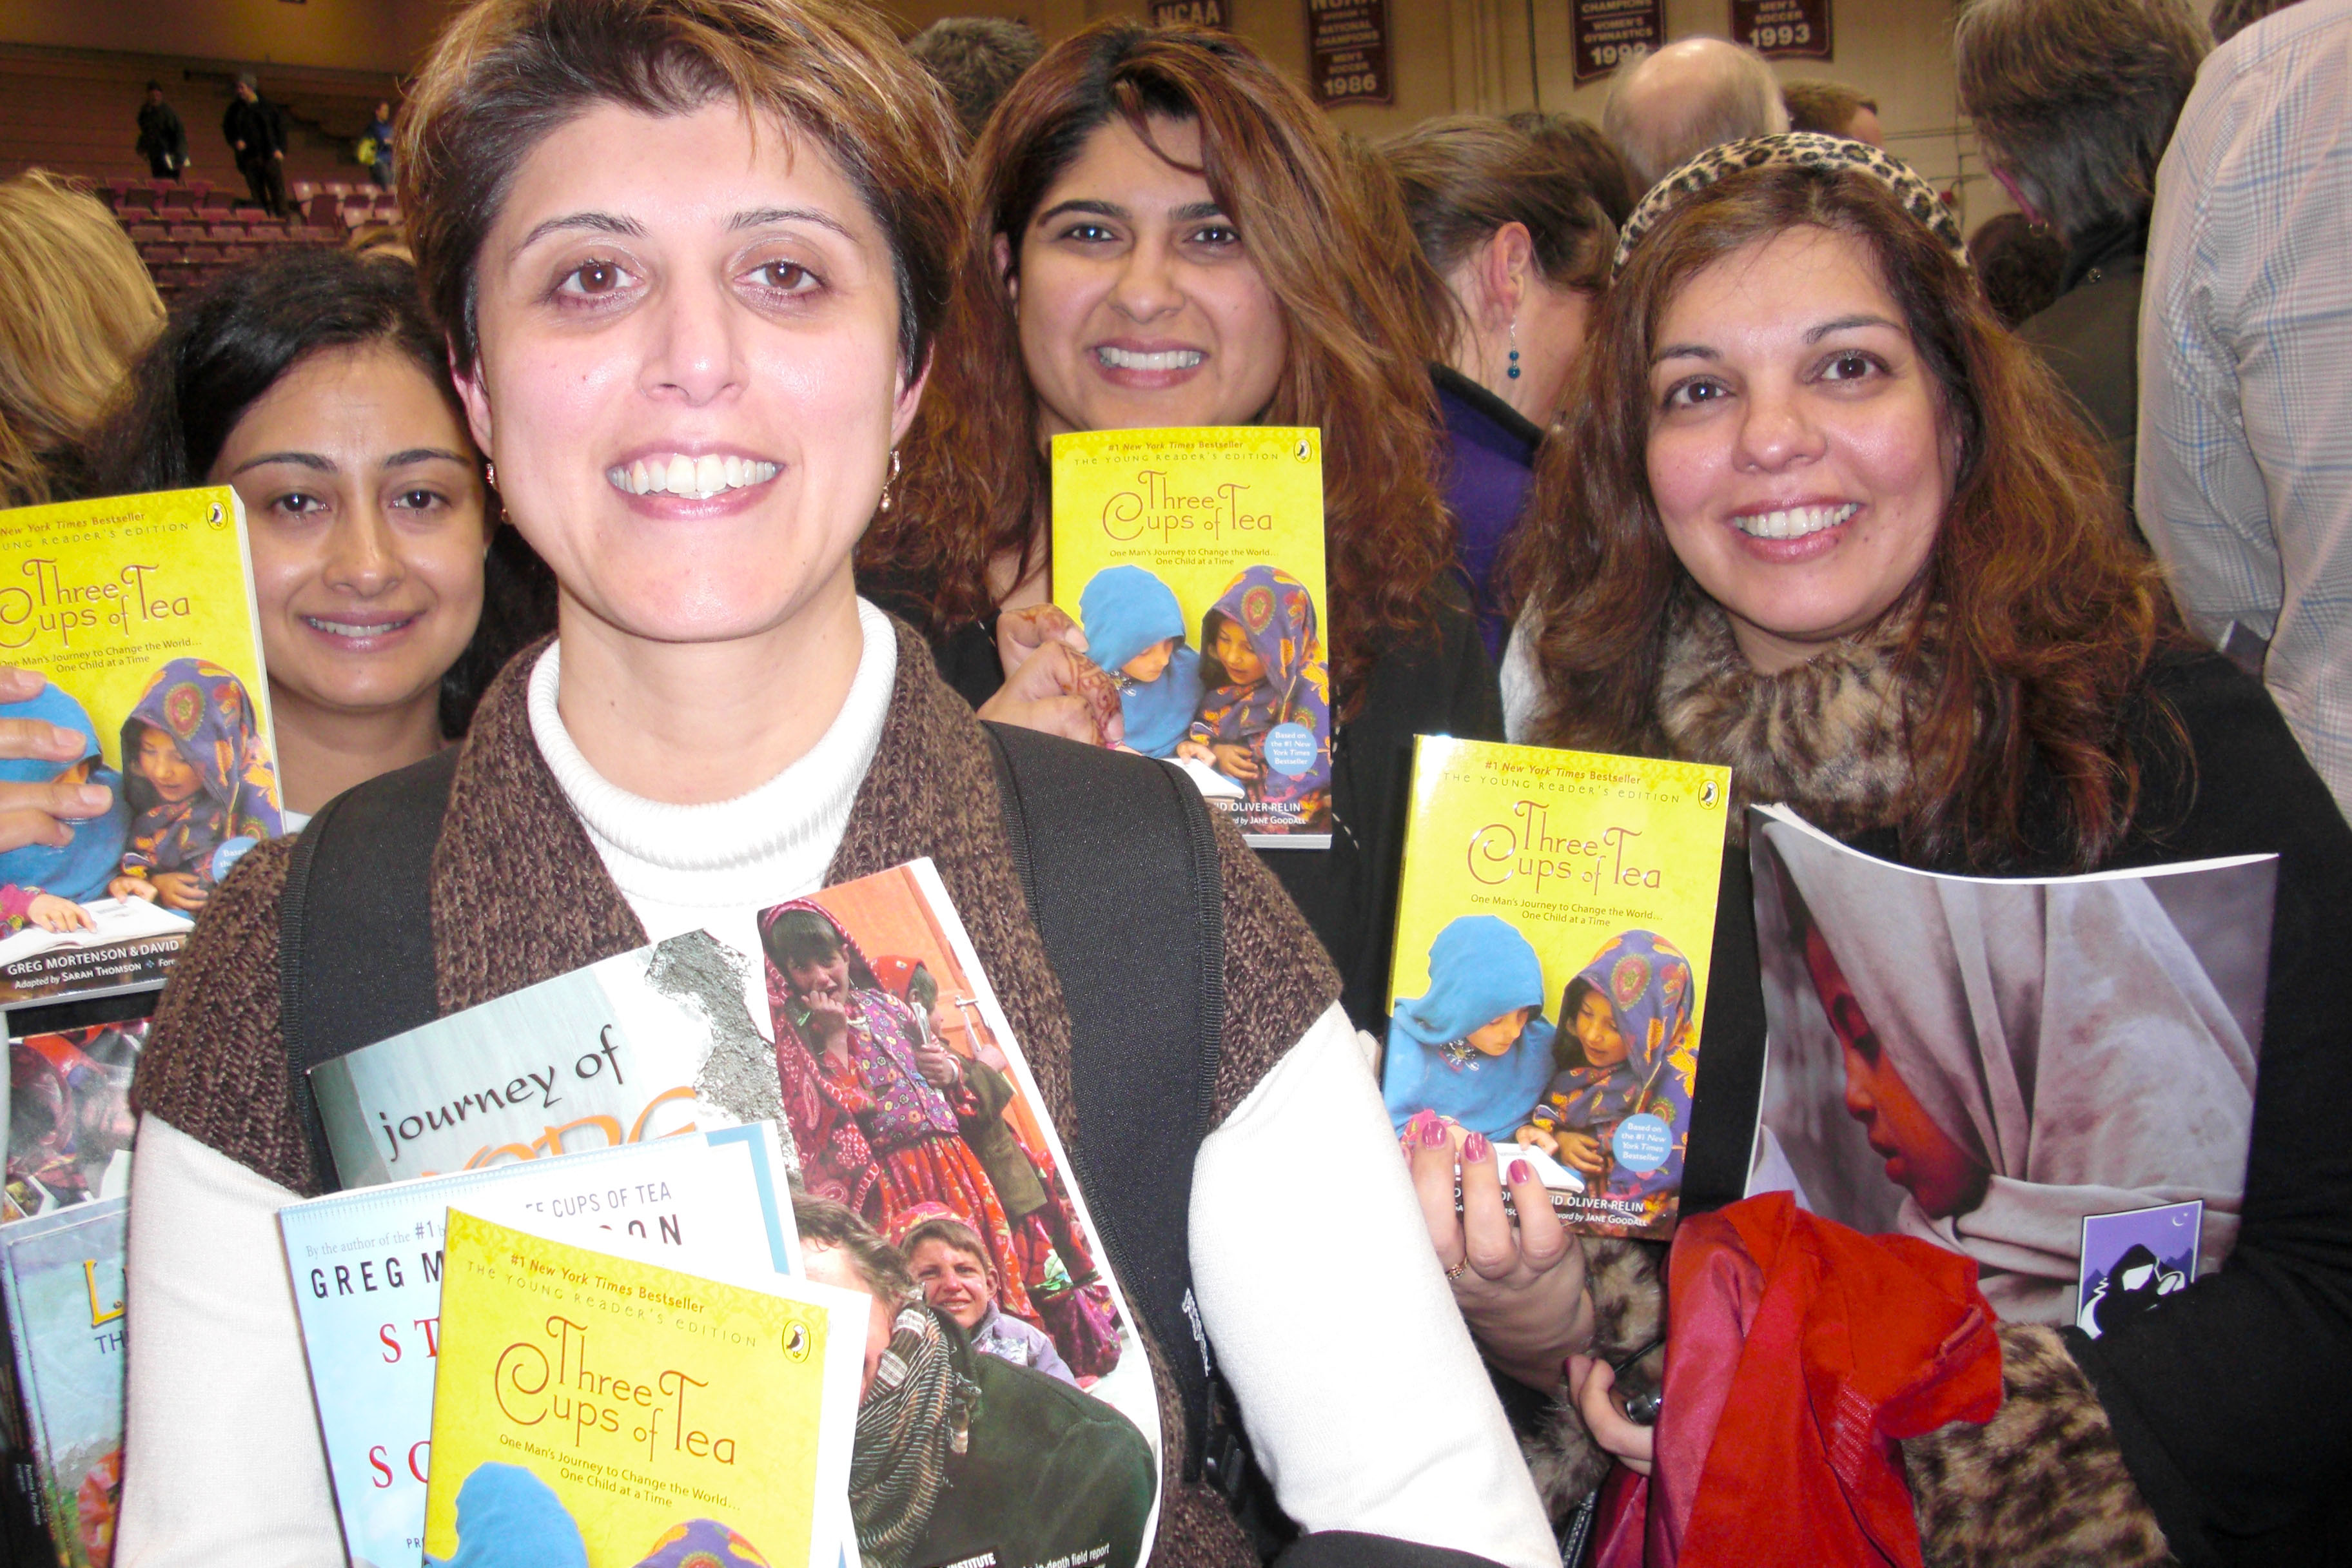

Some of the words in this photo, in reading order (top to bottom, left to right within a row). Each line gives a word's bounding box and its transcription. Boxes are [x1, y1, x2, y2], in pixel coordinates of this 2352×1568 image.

[1158, 0, 1220, 26] NCAA
[1755, 10, 1803, 24] SOCCER
[1750, 22, 1810, 47] 1993
[1324, 74, 1377, 95] 1986
[1108, 443, 1119, 451] #1
[1137, 470, 1214, 509] Three
[0, 527, 21, 536] New
[28, 524, 51, 533] York
[57, 520, 87, 529] Times
[92, 513, 145, 525] Bestseller
[1102, 492, 1194, 543] Cups
[1204, 507, 1222, 540] of
[1218, 483, 1272, 531] Tea
[126, 522, 189, 536] EDITION
[1153, 549, 1186, 558] Journey
[1198, 548, 1229, 558] Change
[22, 558, 119, 607] Three
[0, 587, 97, 649] Cups
[108, 595, 129, 637] of
[121, 564, 191, 621] Tea
[23, 656, 50, 665] Man's
[52, 651, 91, 663] Journey
[106, 645, 142, 656] Change
[145, 642, 161, 651] the
[56, 664, 76, 673] One
[79, 660, 104, 670] Child
[127, 655, 150, 664] Time
[1485, 761, 1498, 770] #1
[1502, 763, 1524, 774] New
[1529, 765, 1551, 776] York
[1556, 767, 1585, 779] Times
[1590, 770, 1641, 785] Bestseller
[1480, 776, 1531, 789] YOUNG
[1618, 789, 1681, 803] EDITION
[1231, 803, 1268, 812] OLIVER
[1271, 803, 1300, 812] RELIN
[1240, 817, 1248, 825] by
[1514, 799, 1598, 856] Three
[1467, 824, 1571, 894] Cups
[1582, 855, 1605, 896] of
[1603, 827, 1661, 889] Tea
[1471, 894, 1490, 904] One
[1493, 896, 1518, 907] Man's
[1520, 899, 1557, 913] Journey
[1559, 903, 1569, 912] to
[1571, 903, 1607, 917] Change
[1609, 906, 1624, 917] the
[1522, 910, 1541, 921] One
[1543, 912, 1567, 923] Child
[1569, 915, 1579, 923] at
[1588, 916, 1611, 926] Time
[8, 960, 43, 975] GREG
[46, 948, 128, 970] MORTENSON
[130, 946, 139, 957] &
[140, 940, 179, 956] DAVID
[15, 976, 49, 990] Adapted
[50, 975, 61, 985] by
[61, 970, 93, 981] SARAH
[95, 963, 142, 977] THOMSON
[379, 1065, 562, 1161] journey
[575, 1024, 624, 1086] of
[1628, 1122, 1651, 1131] Based
[1647, 1134, 1666, 1142] New
[1623, 1151, 1660, 1161] Bestseller
[1641, 1143, 1663, 1152] Times
[553, 1193, 600, 1217] CUPS
[607, 1188, 627, 1208] OF
[635, 1182, 671, 1204] TEA
[1567, 1196, 1607, 1209] OLIVER
[1612, 1200, 1643, 1212] RELIN
[1575, 1213, 1585, 1222] by
[1585, 1213, 1606, 1222] JANE
[1608, 1215, 1647, 1226] GOODALL
[306, 1245, 319, 1260] By
[322, 1242, 338, 1255] the
[341, 1237, 375, 1252] author
[379, 1232, 390, 1245] of
[393, 1231, 410, 1244] the
[415, 1220, 433, 1240] #1
[311, 1257, 404, 1298] GREG
[511, 1253, 526, 1268] #1
[529, 1259, 556, 1277] New
[561, 1268, 588, 1286] York
[594, 1276, 632, 1297] Times
[638, 1286, 705, 1314] Bestseller
[505, 1274, 564, 1300] YOUNG
[676, 1318, 757, 1348] EDITION
[546, 1315, 652, 1407] Three
[495, 1342, 619, 1447] Cups
[633, 1407, 663, 1462] of
[659, 1370, 736, 1465] Tea
[500, 1433, 522, 1450] One
[524, 1440, 555, 1460] Man's
[557, 1451, 603, 1475] Journey
[607, 1463, 618, 1476] to
[621, 1466, 667, 1493] Change
[670, 1481, 689, 1496] the
[560, 1467, 583, 1484] One
[586, 1475, 616, 1494] Child
[620, 1485, 631, 1498] at
[634, 1491, 641, 1500] a
[643, 1490, 673, 1507] Time
[1072, 1550, 1087, 1566] field
[1090, 1542, 1110, 1560] report
